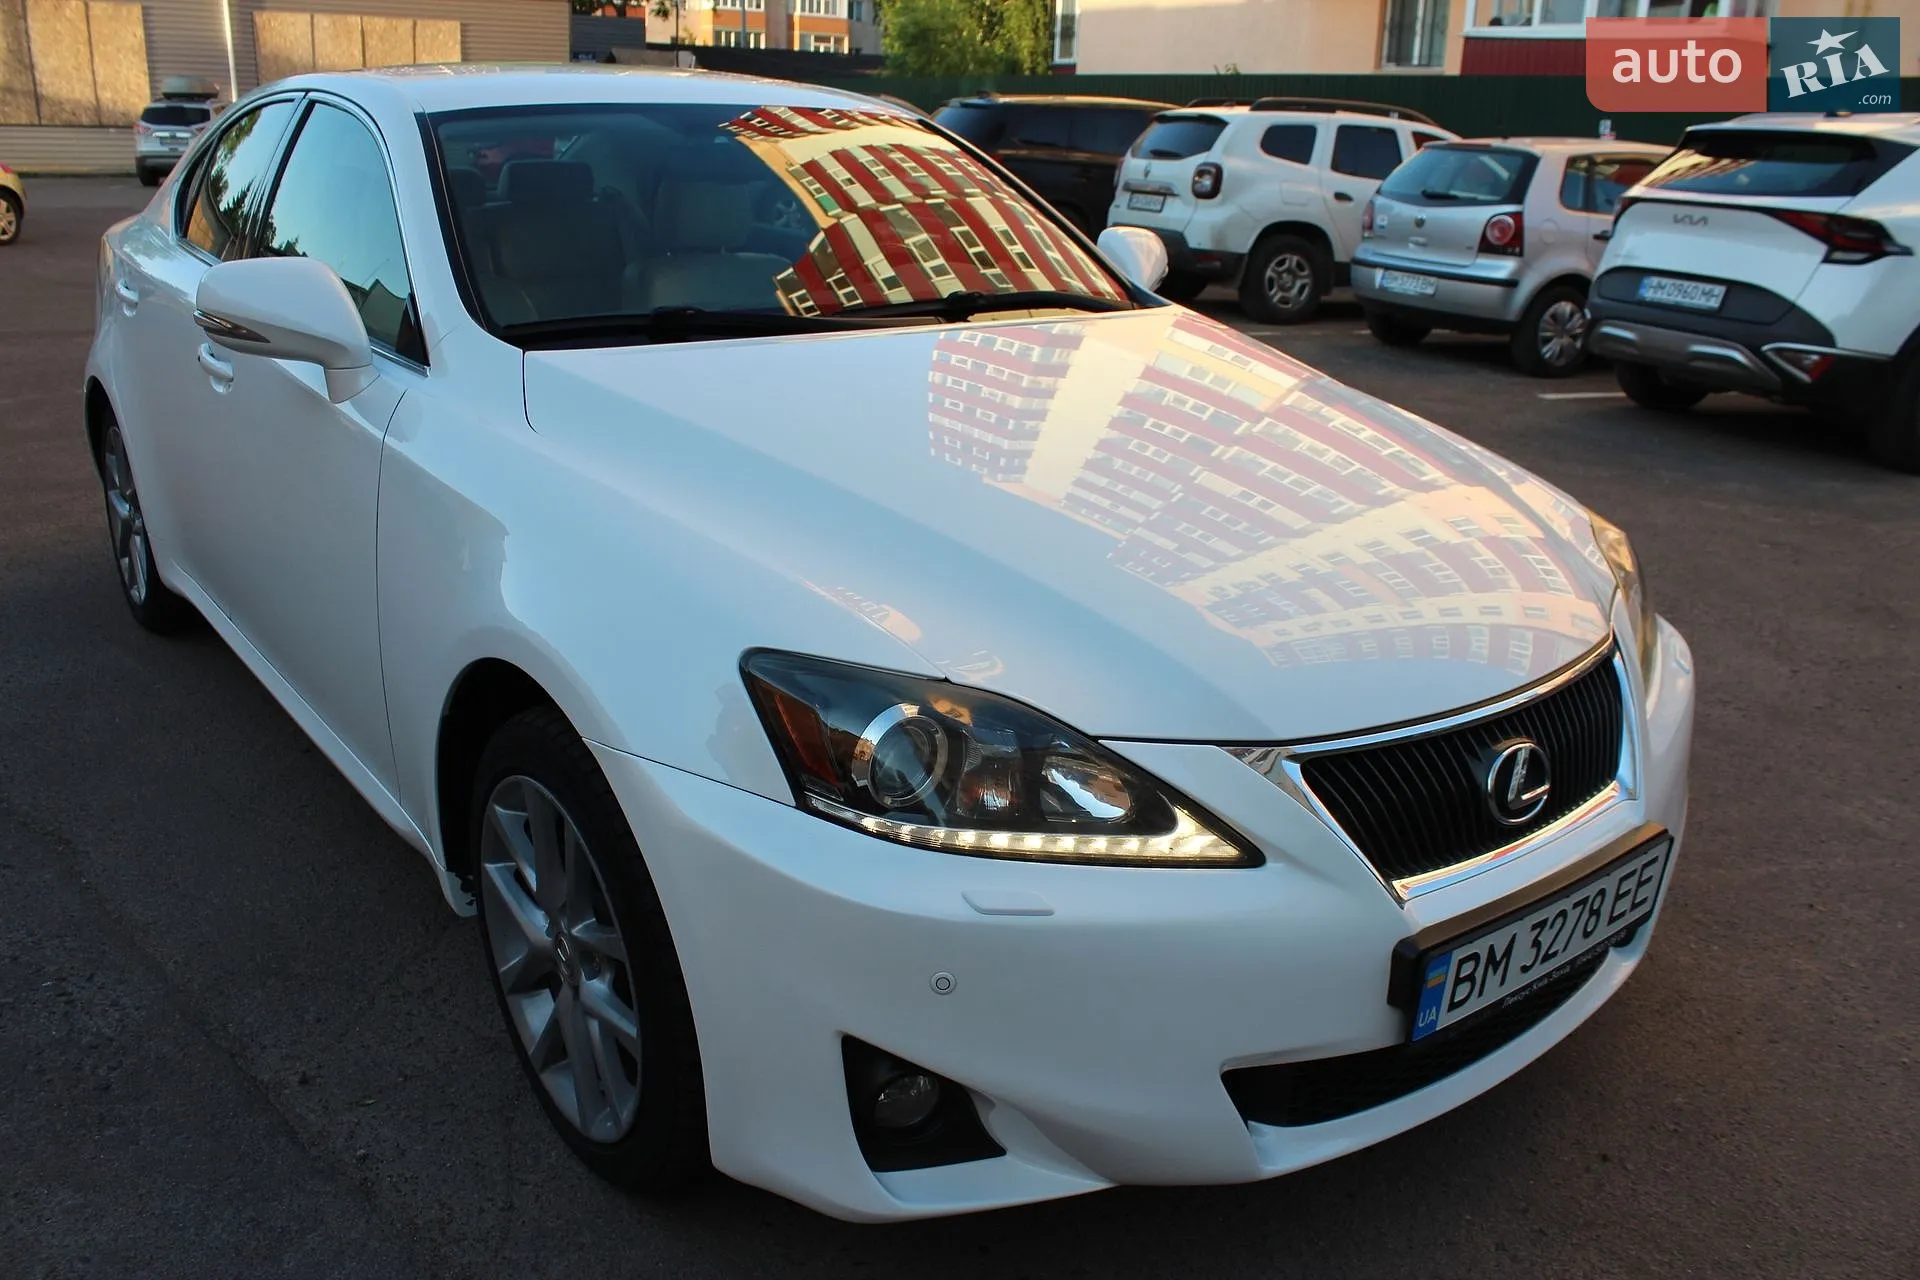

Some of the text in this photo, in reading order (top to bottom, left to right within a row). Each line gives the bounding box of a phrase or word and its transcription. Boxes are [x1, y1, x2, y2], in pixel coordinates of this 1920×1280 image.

[1447, 933, 1517, 1014] BM
[1520, 887, 1607, 974] 3278
[1607, 856, 1659, 927] EE
[1418, 1009, 1437, 1028] UA
